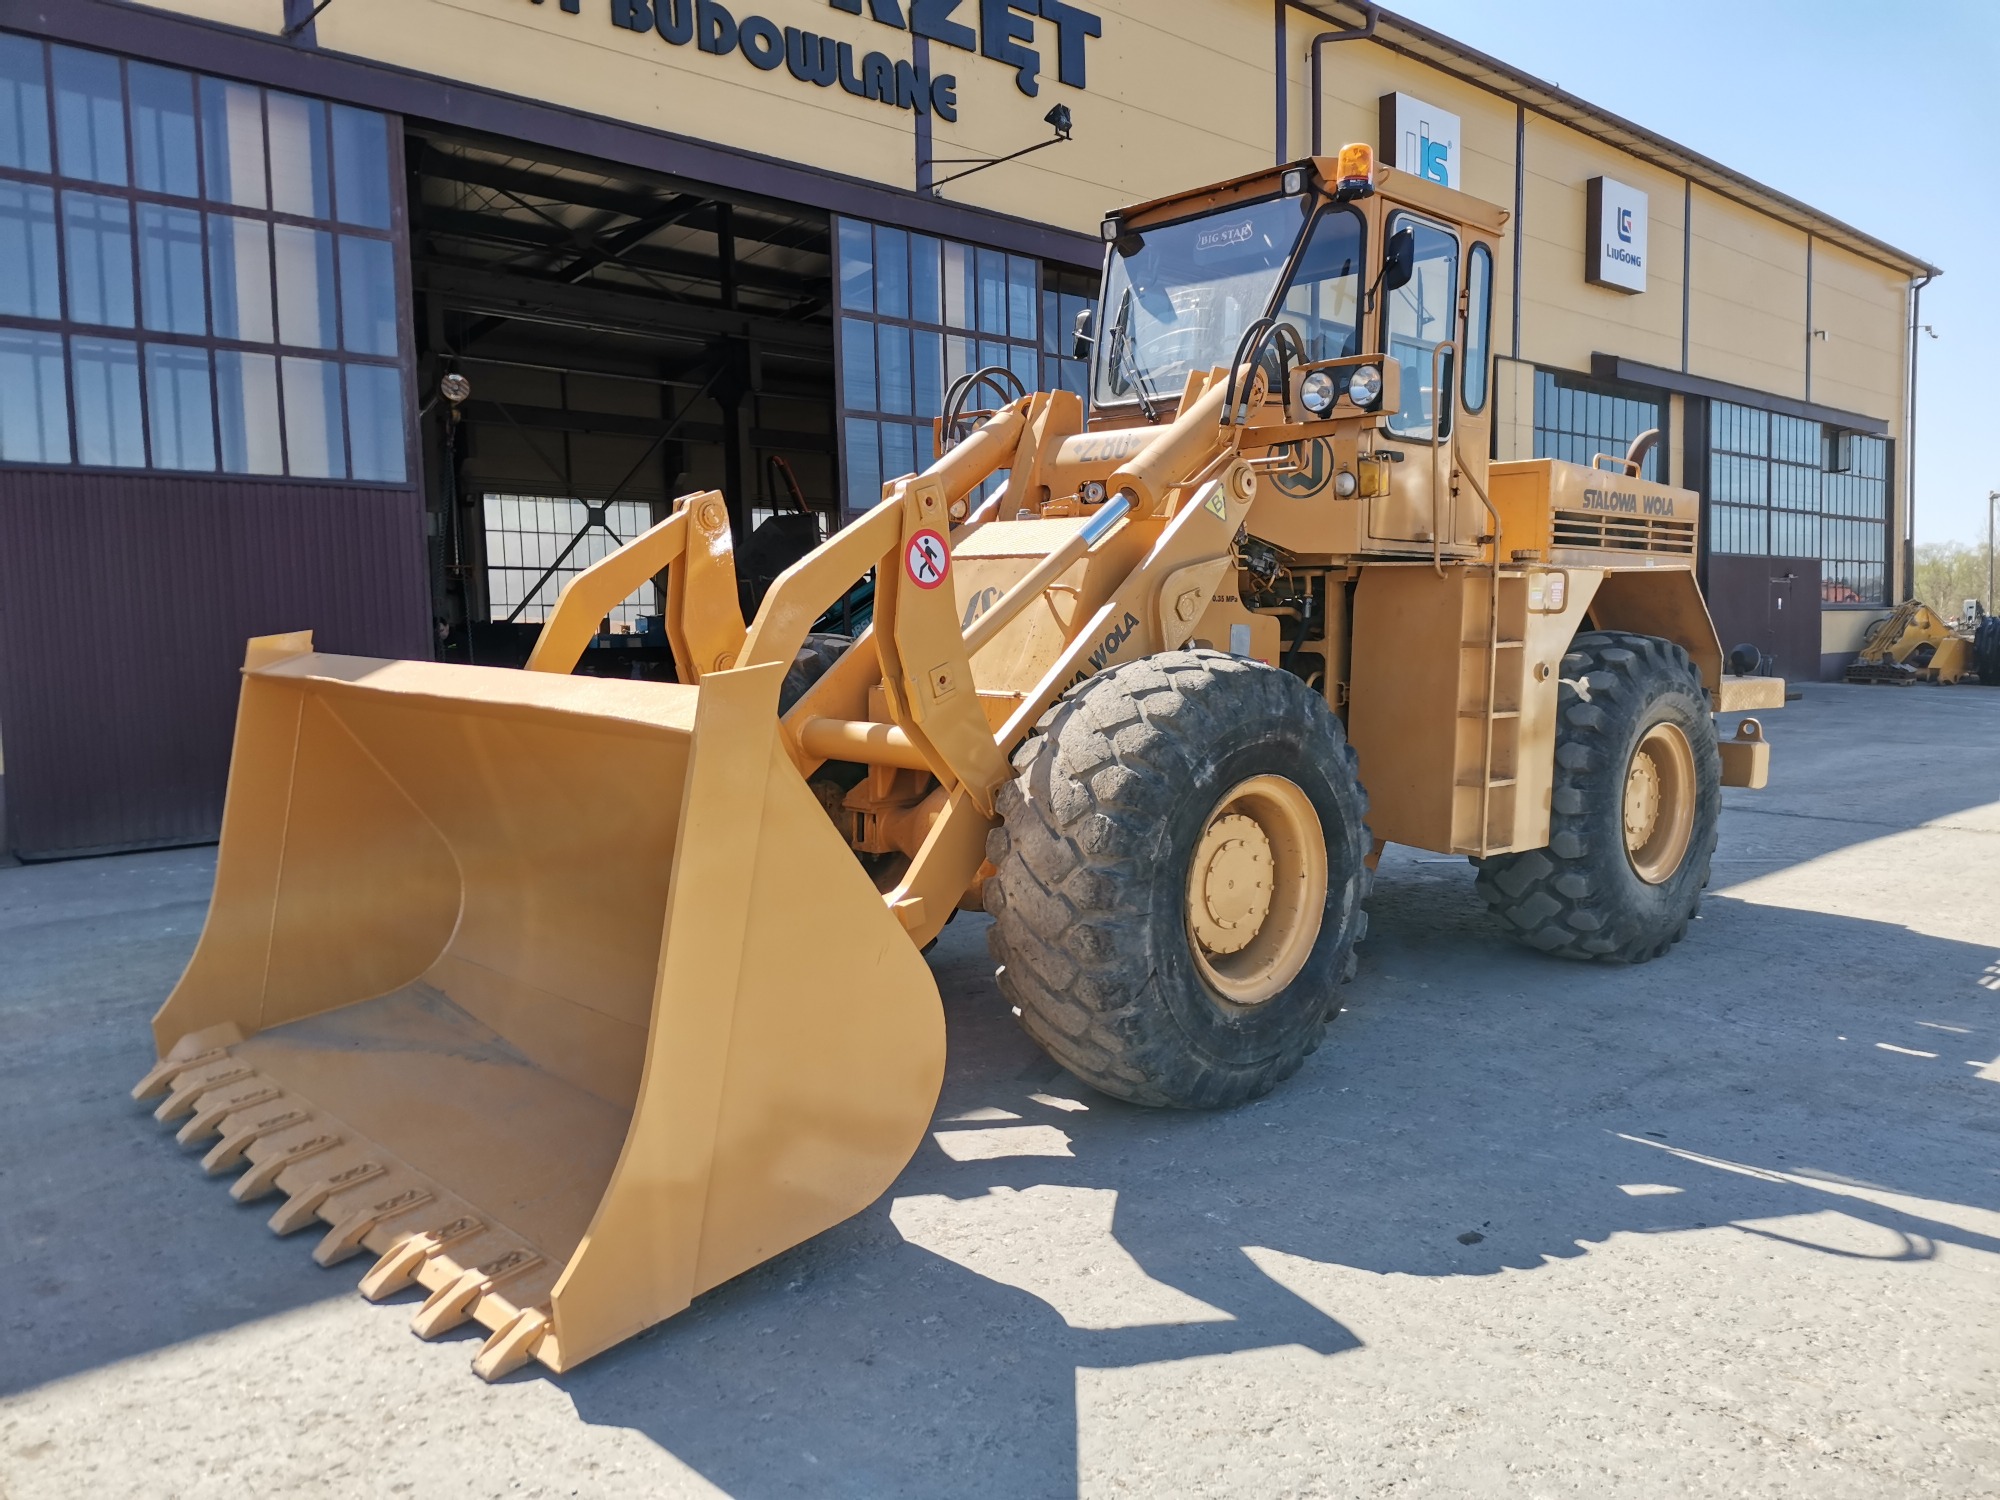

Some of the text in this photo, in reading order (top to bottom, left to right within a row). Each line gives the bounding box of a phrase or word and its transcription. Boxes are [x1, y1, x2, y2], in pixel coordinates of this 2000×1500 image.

[1201, 233, 1219, 245] BIG
[1582, 488, 1674, 517] STALOWA WOLA
[1087, 611, 1140, 671] WOLA
